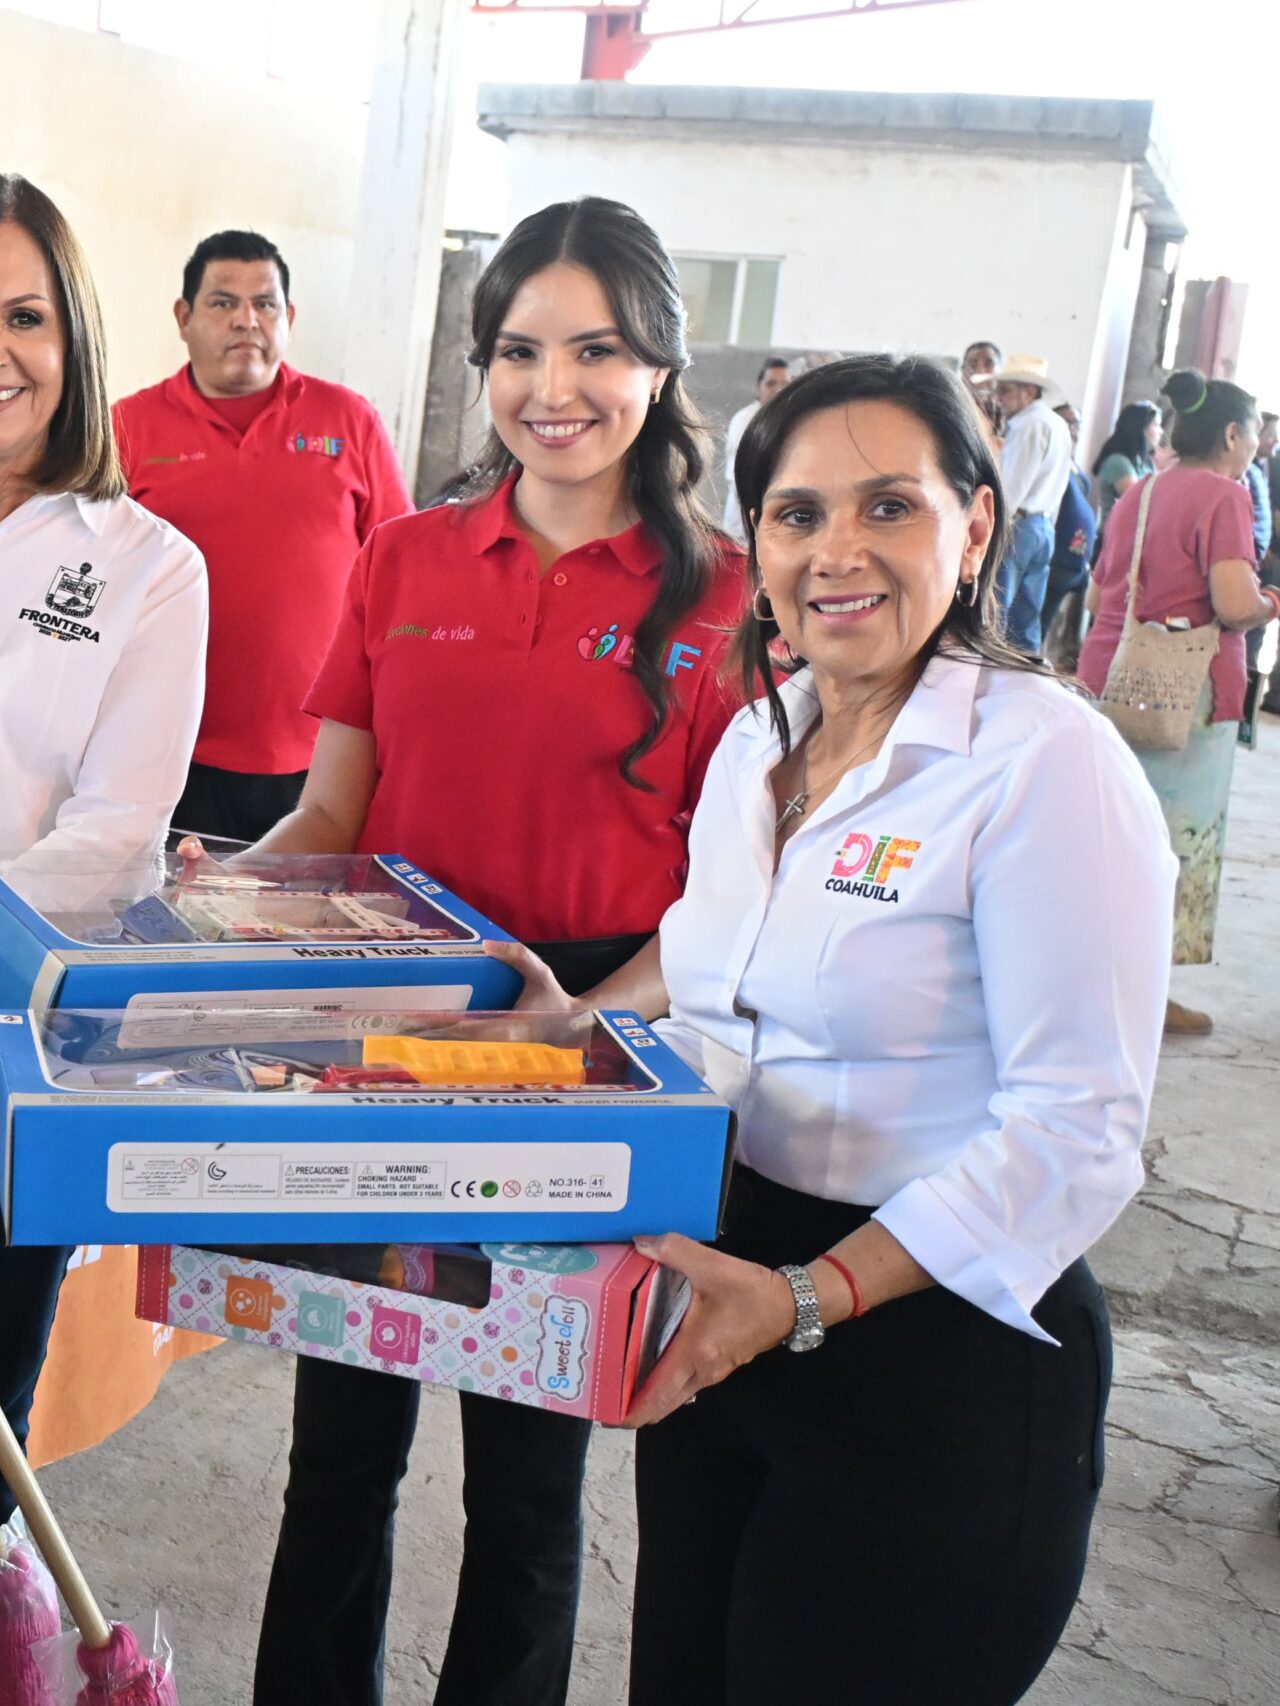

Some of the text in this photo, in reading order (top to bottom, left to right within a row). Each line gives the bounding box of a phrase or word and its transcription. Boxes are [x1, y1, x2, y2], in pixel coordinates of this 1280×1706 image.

[18, 608, 100, 643] FRONTERA
[431, 626, 447, 640] de
[450, 625, 476, 640] vida
[830, 832, 922, 885] DIF
[824, 878, 900, 904] COAHUILA
[293, 947, 367, 958] Heavy
[365, 946, 436, 956] Truck
[351, 1096, 455, 1106] Heavy
[463, 1096, 565, 1105] Truck
[295, 1165, 351, 1175] PRECAUCIONES:
[385, 1164, 431, 1174] WARNING:
[591, 1178, 603, 1186] 41
[548, 1191, 613, 1199] MADE IN CHINA
[547, 1340, 572, 1389] Sweet
